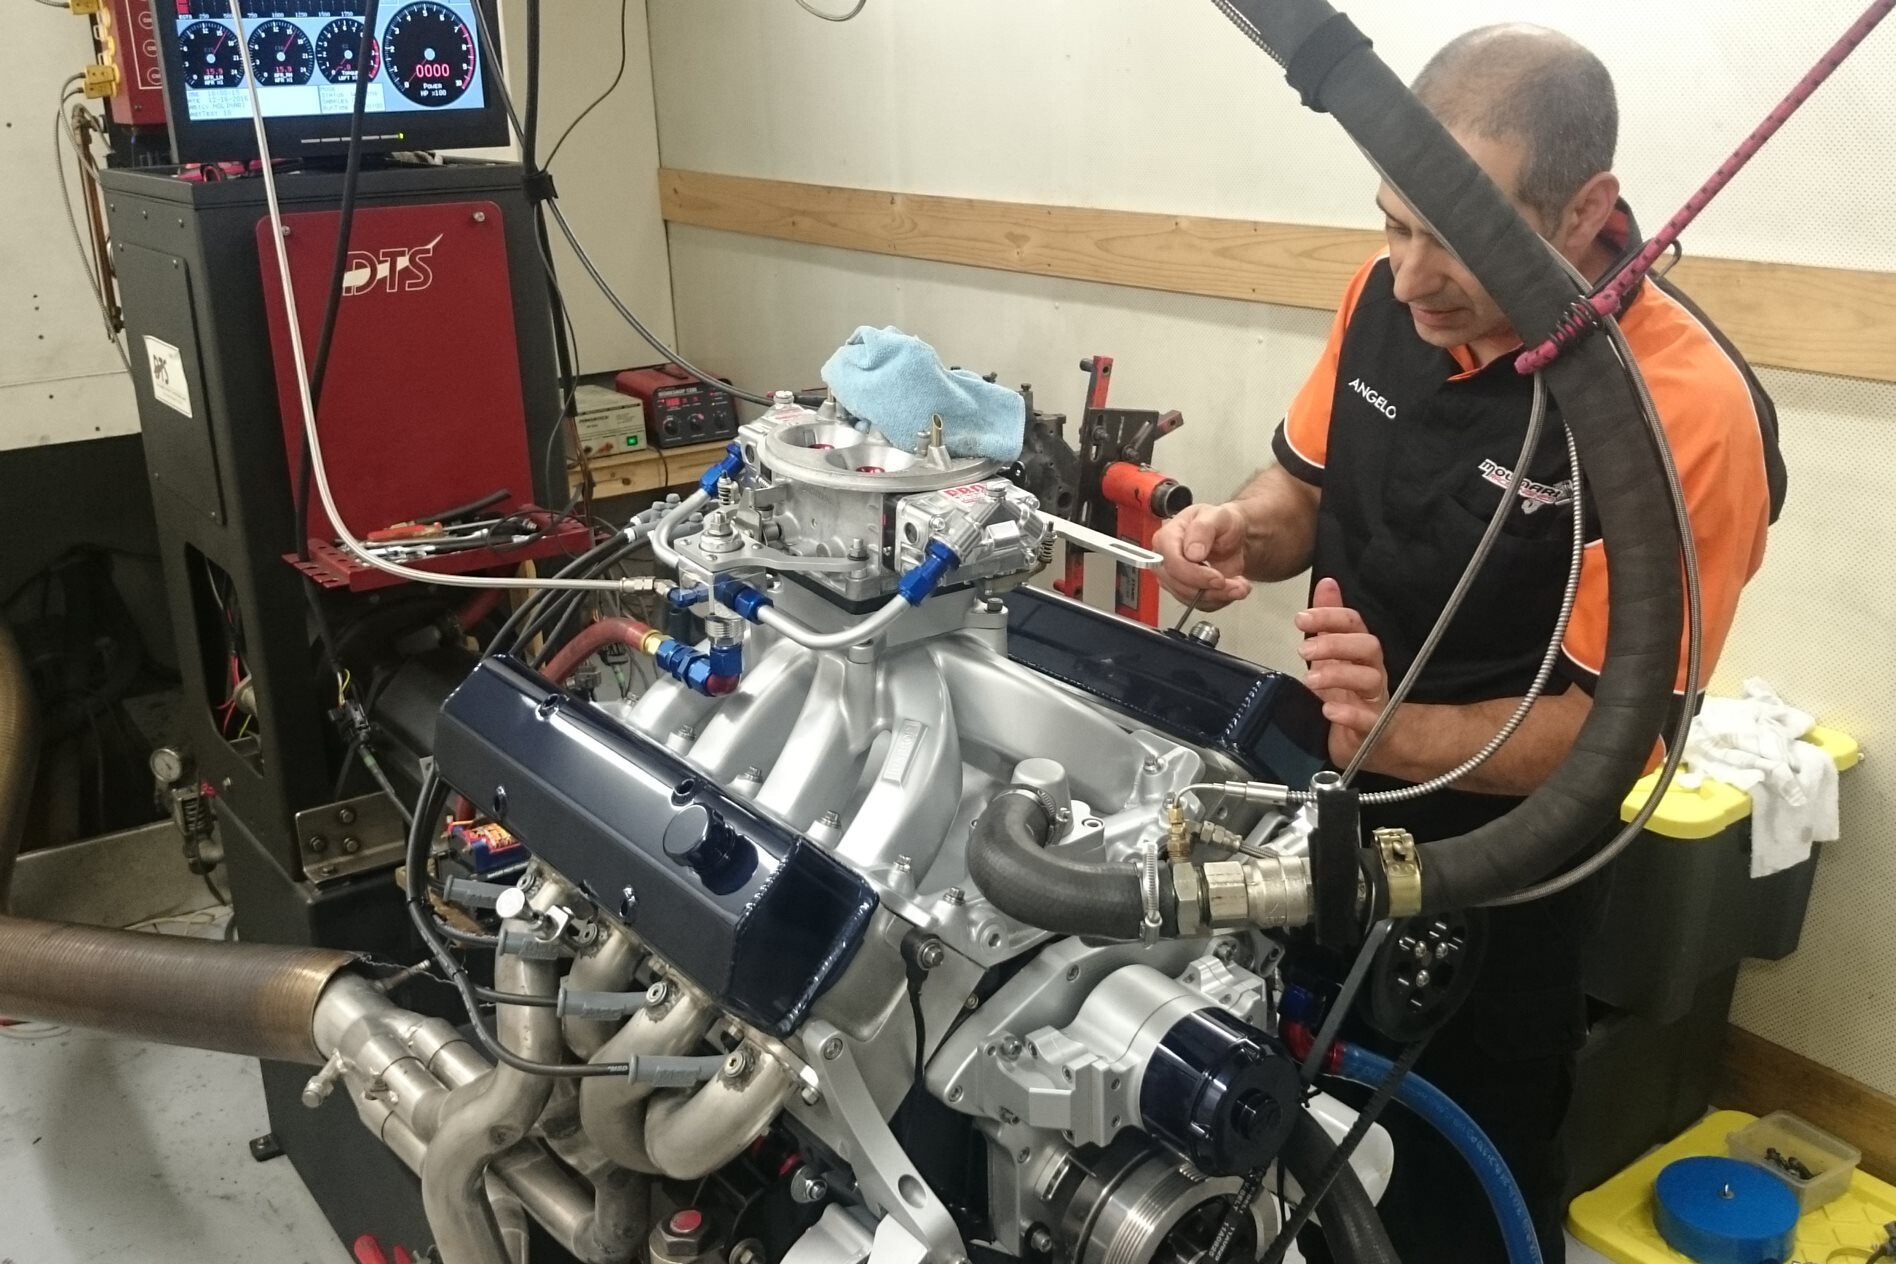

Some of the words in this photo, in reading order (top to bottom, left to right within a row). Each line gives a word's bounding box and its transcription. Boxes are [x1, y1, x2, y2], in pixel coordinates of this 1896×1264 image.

[416, 64, 450, 78] 0000
[343, 246, 433, 296] DTS
[1348, 377, 1397, 419] ANGELO
[1479, 459, 1562, 498] MOLNARI
